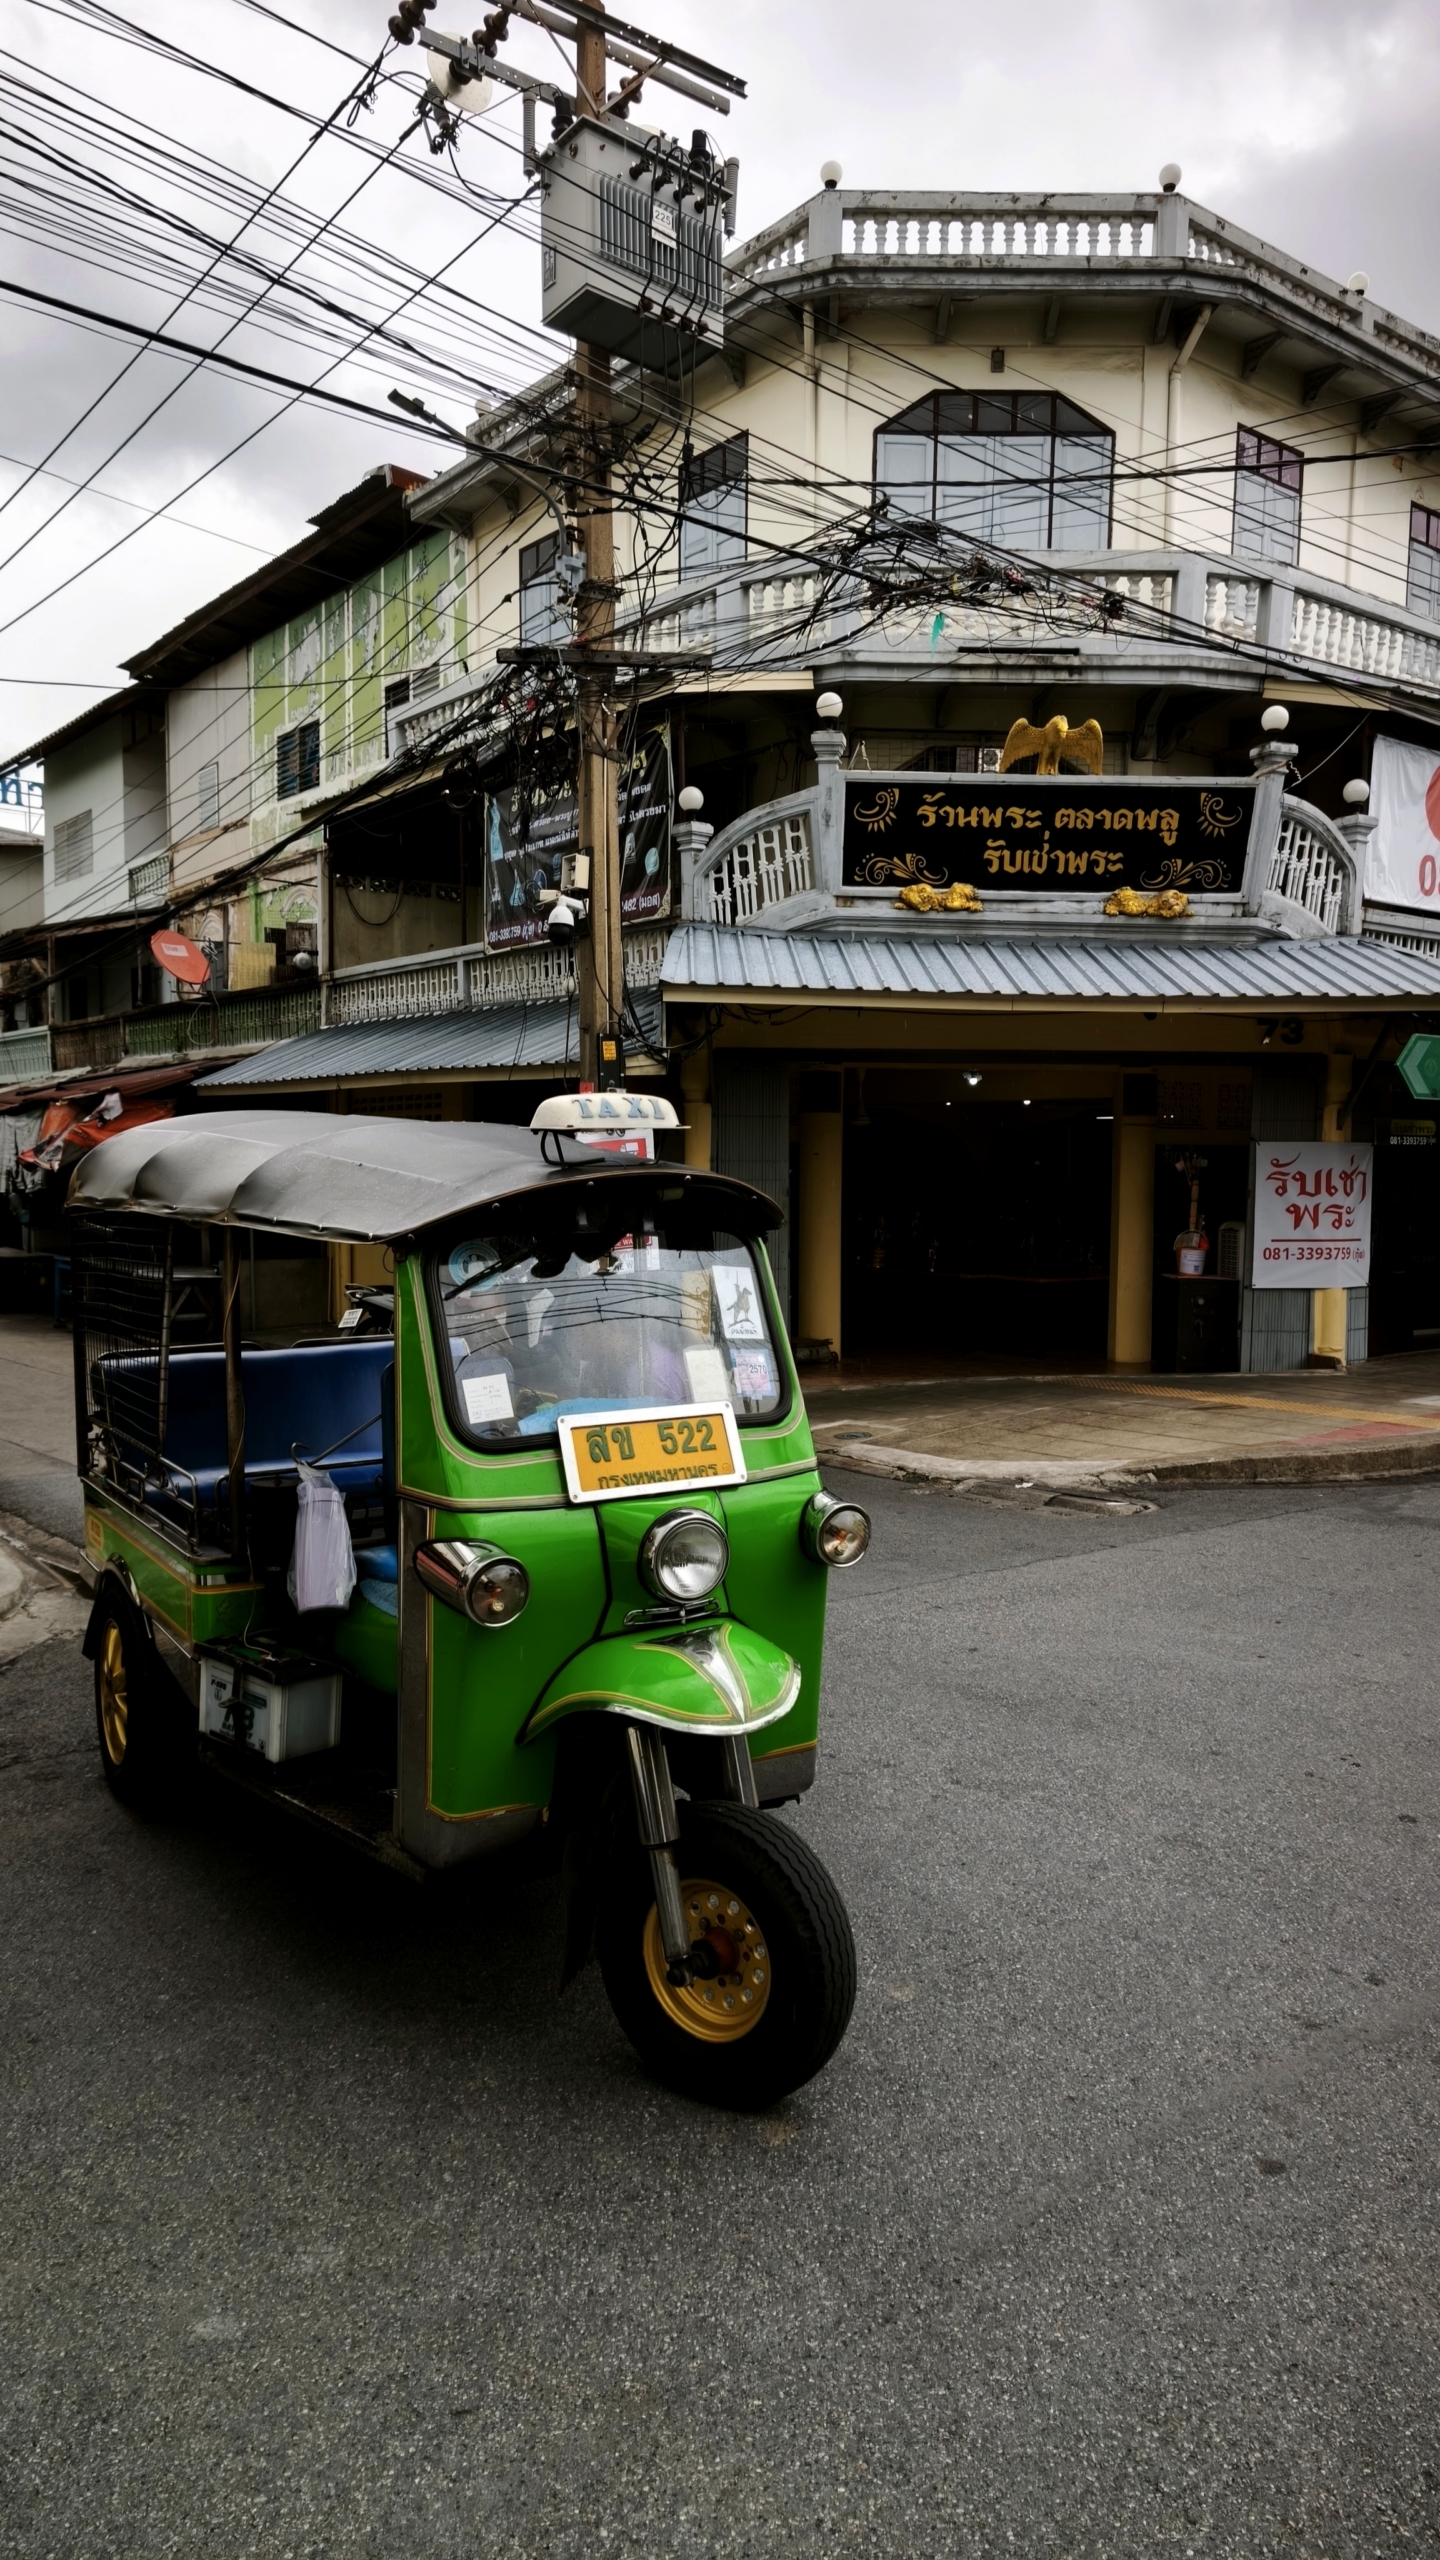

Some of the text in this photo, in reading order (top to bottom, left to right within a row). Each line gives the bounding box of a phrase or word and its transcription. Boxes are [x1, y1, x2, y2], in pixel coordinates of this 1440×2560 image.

[654, 210, 671, 226] 225
[916, 791, 1180, 847] ร้านพระ ตลาดพลู
[983, 830, 1124, 875] รับเช่าพระ
[1256, 1017, 1305, 1046] 73
[571, 1096, 666, 1120] TAXI
[1265, 1151, 1368, 1205] รับเช่า
[1285, 1202, 1356, 1231] พระ
[1262, 1247, 1351, 1261] 081-3393759
[586, 1418, 717, 1463] สข 522
